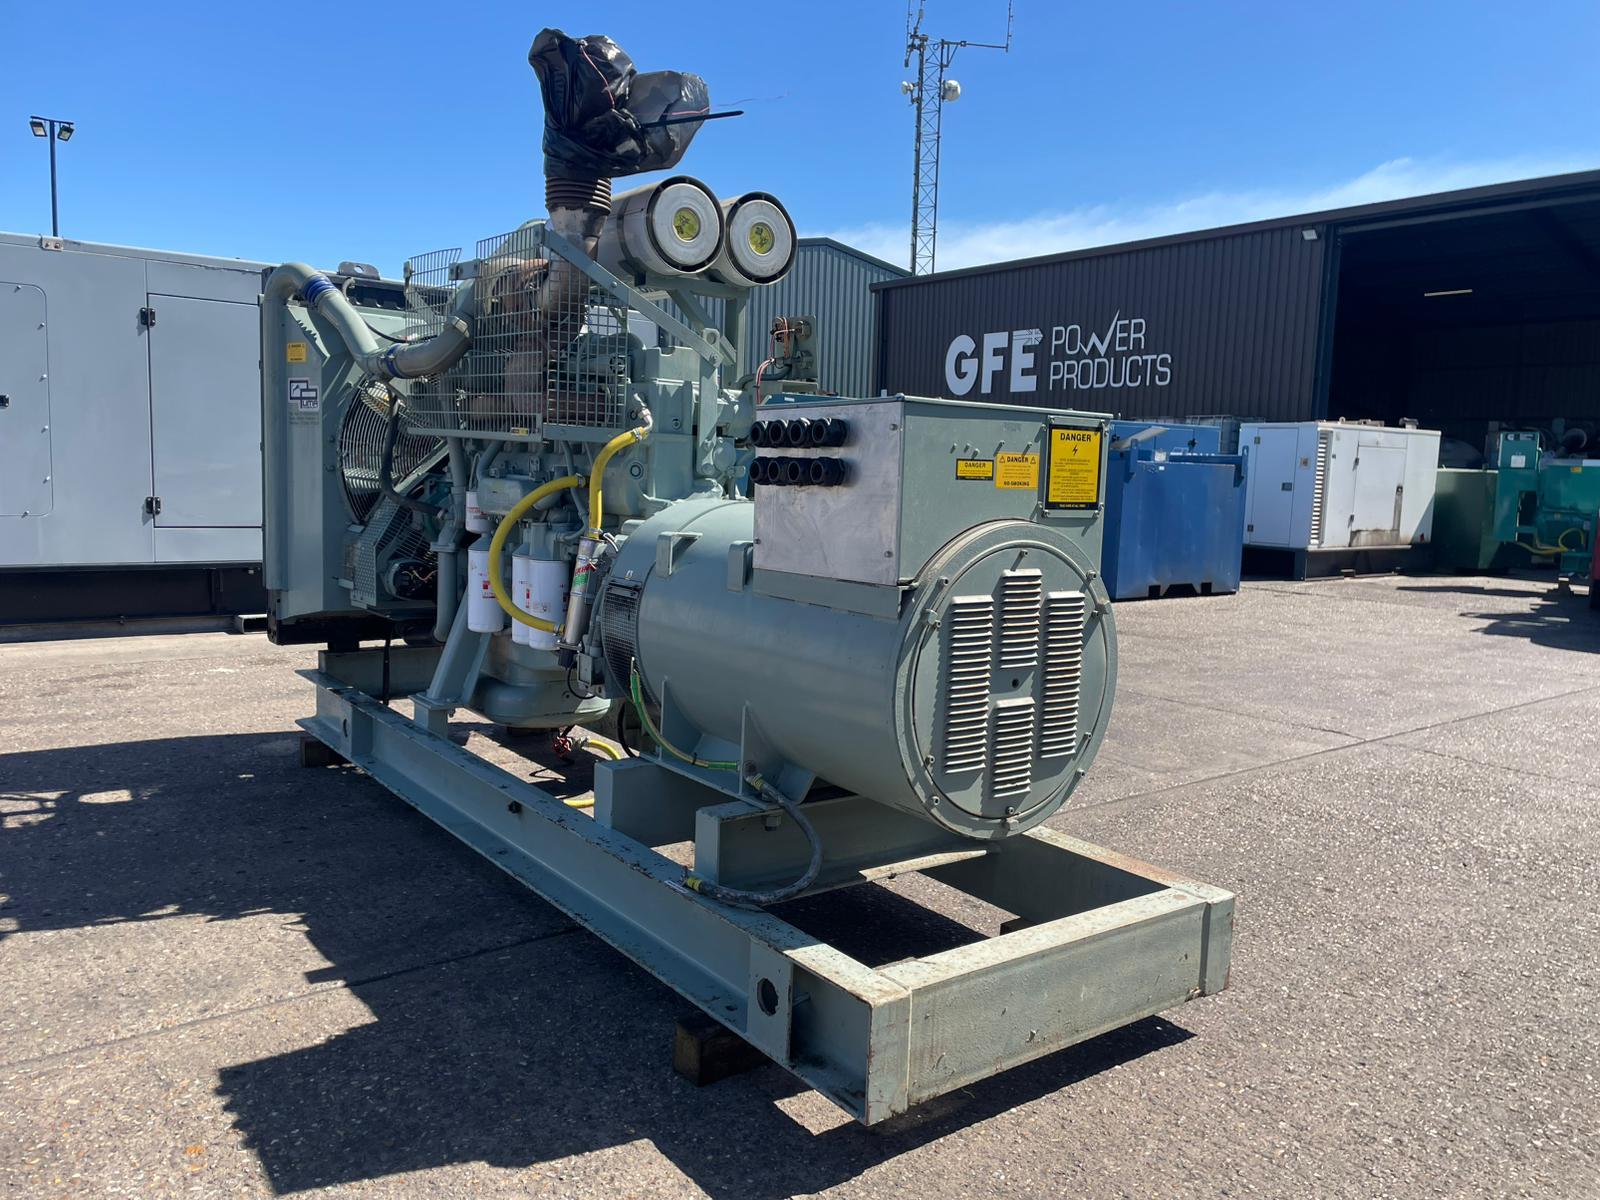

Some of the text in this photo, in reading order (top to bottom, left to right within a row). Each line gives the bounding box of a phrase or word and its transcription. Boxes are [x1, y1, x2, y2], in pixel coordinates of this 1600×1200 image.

[1051, 309, 1146, 357] POWER
[945, 328, 1043, 396] GFE
[1049, 353, 1172, 391] PRODUCTS
[1060, 433, 1092, 442] DANGER
